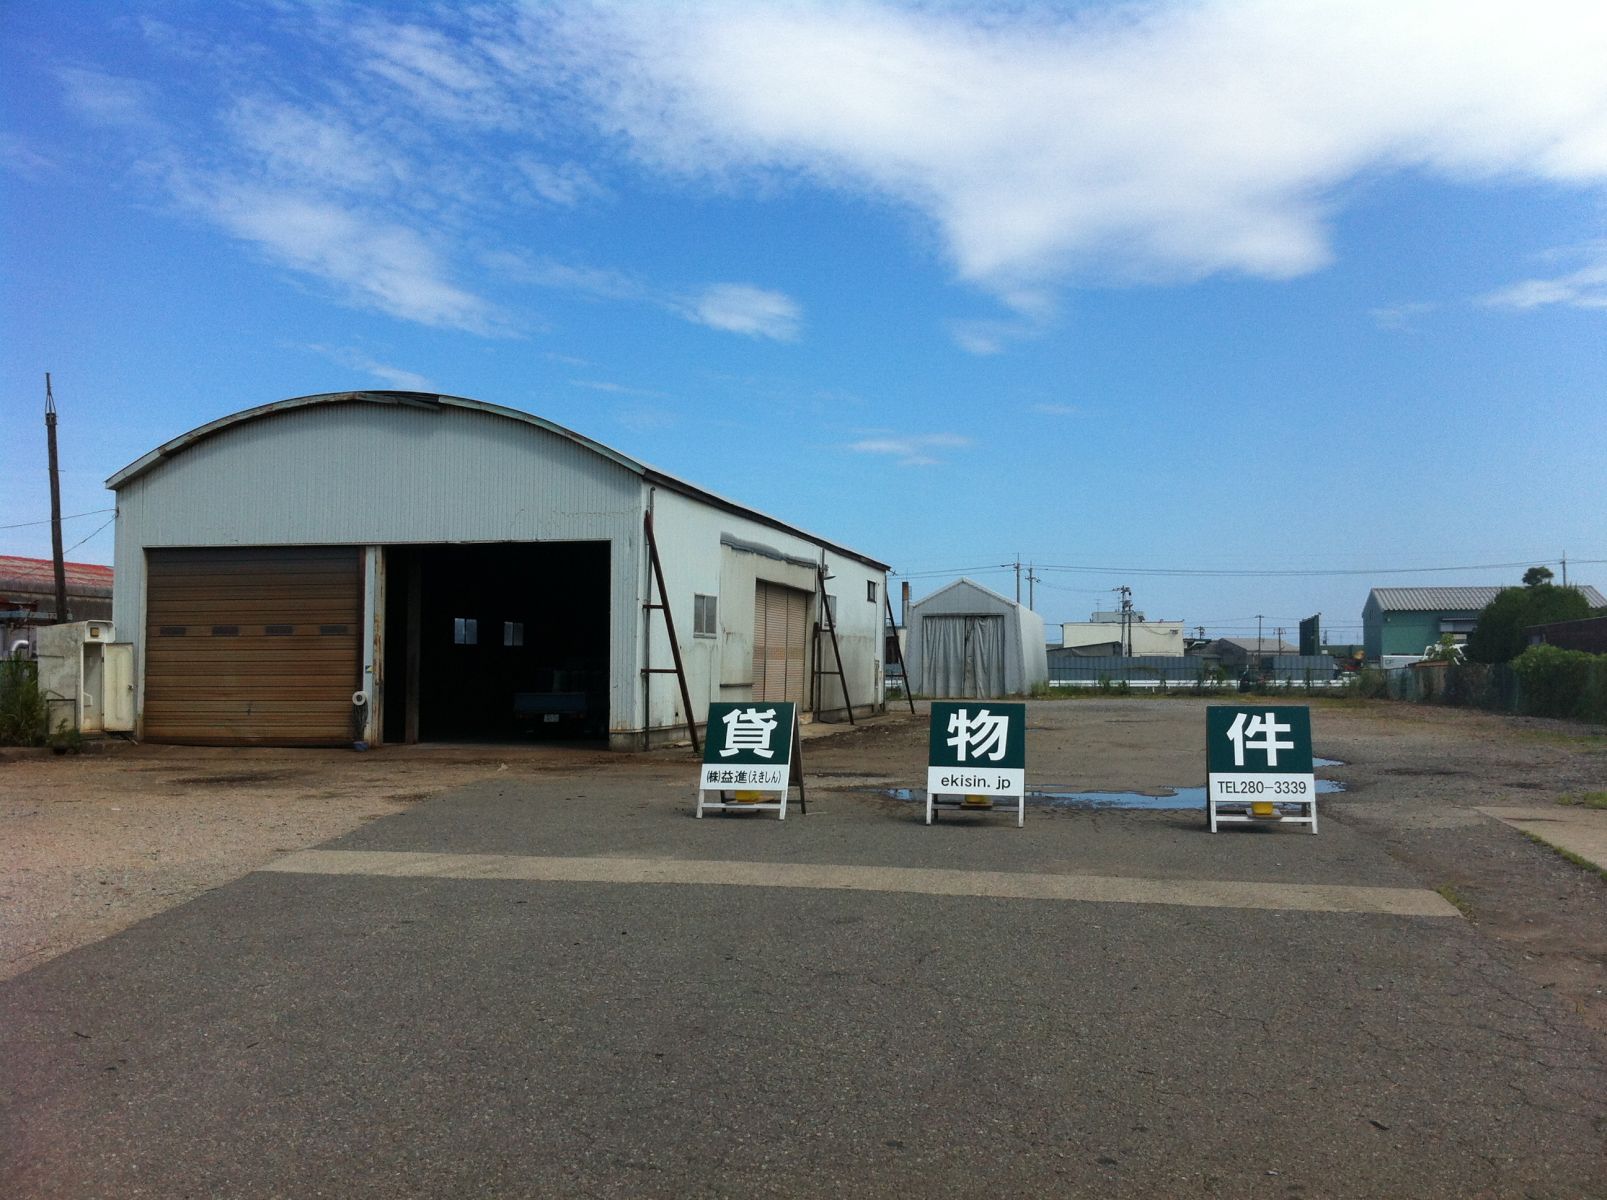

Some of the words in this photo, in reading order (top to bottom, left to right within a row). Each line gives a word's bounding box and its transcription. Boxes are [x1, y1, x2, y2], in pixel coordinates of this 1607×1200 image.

[718, 708, 778, 759] 貸
[946, 708, 1009, 762] 物
[1226, 712, 1295, 767] 件
